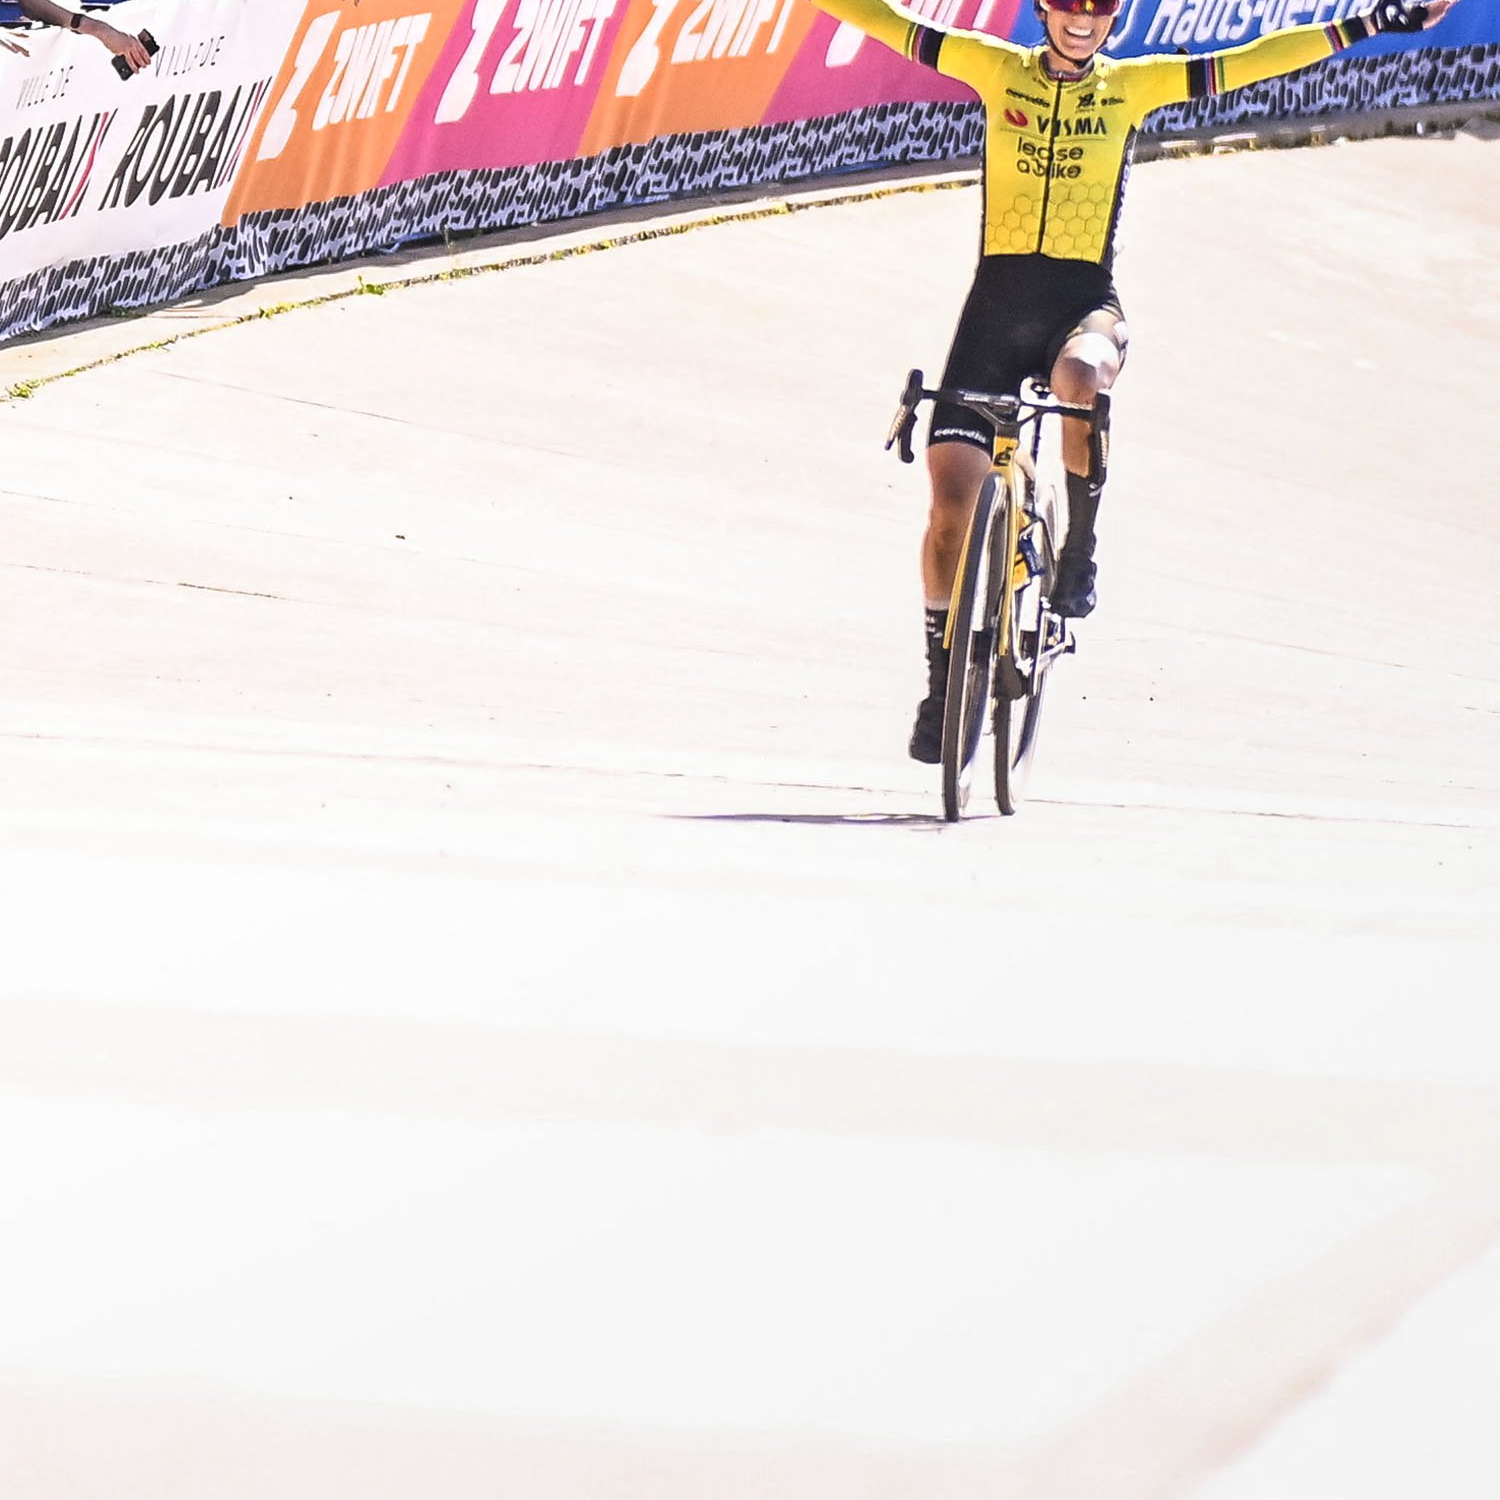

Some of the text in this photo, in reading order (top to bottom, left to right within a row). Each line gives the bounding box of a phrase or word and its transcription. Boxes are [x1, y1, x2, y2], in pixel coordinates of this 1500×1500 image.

[312, 13, 433, 131] ZWIFT
[98, 76, 272, 213] ROUBAIX
[1017, 136, 1084, 162] lease
[1036, 115, 1107, 137] VISMA
